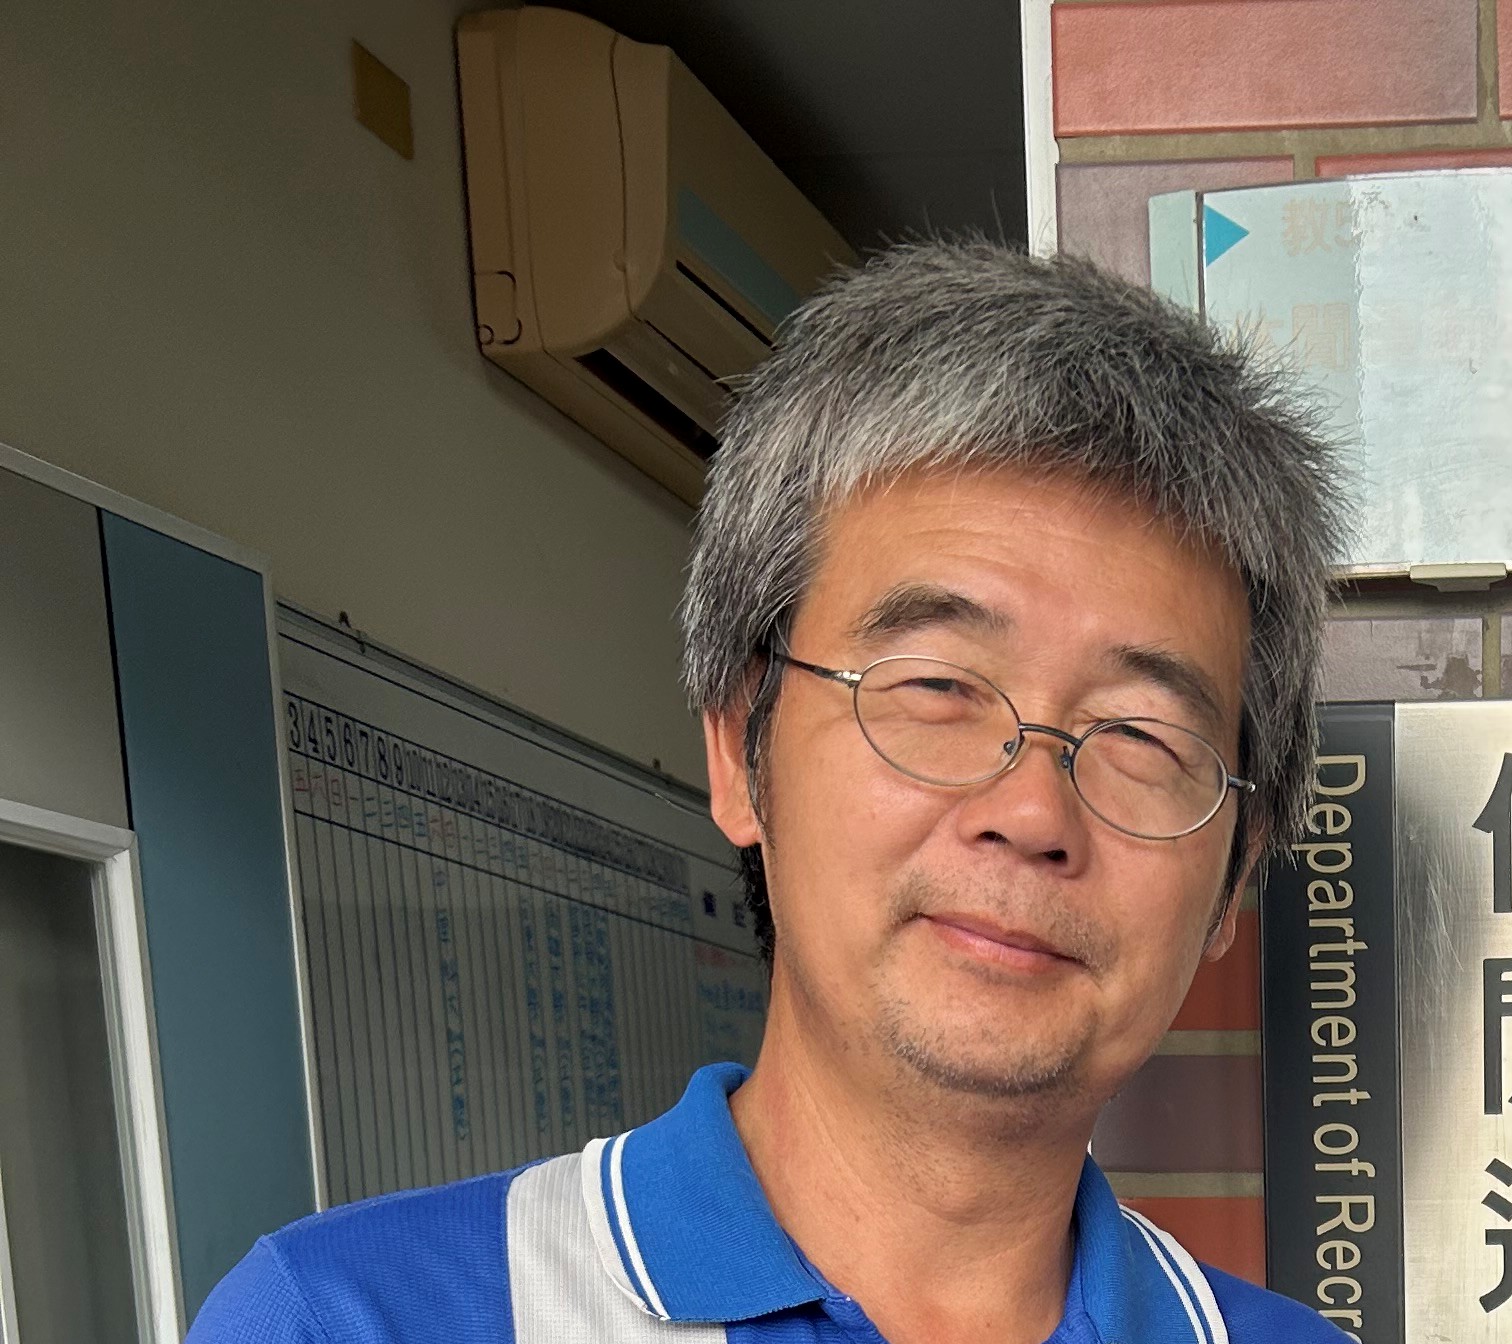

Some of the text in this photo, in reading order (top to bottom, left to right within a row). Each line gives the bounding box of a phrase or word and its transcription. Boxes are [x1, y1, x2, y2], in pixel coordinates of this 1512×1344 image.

[288, 701, 300, 749] 3
[308, 710, 319, 753] 4
[324, 716, 336, 761] 5
[343, 722, 354, 767] 6
[359, 731, 370, 771] 7
[378, 735, 388, 780] 8
[393, 743, 403, 787] 9
[1291, 754, 1376, 1344] Department of Recr
